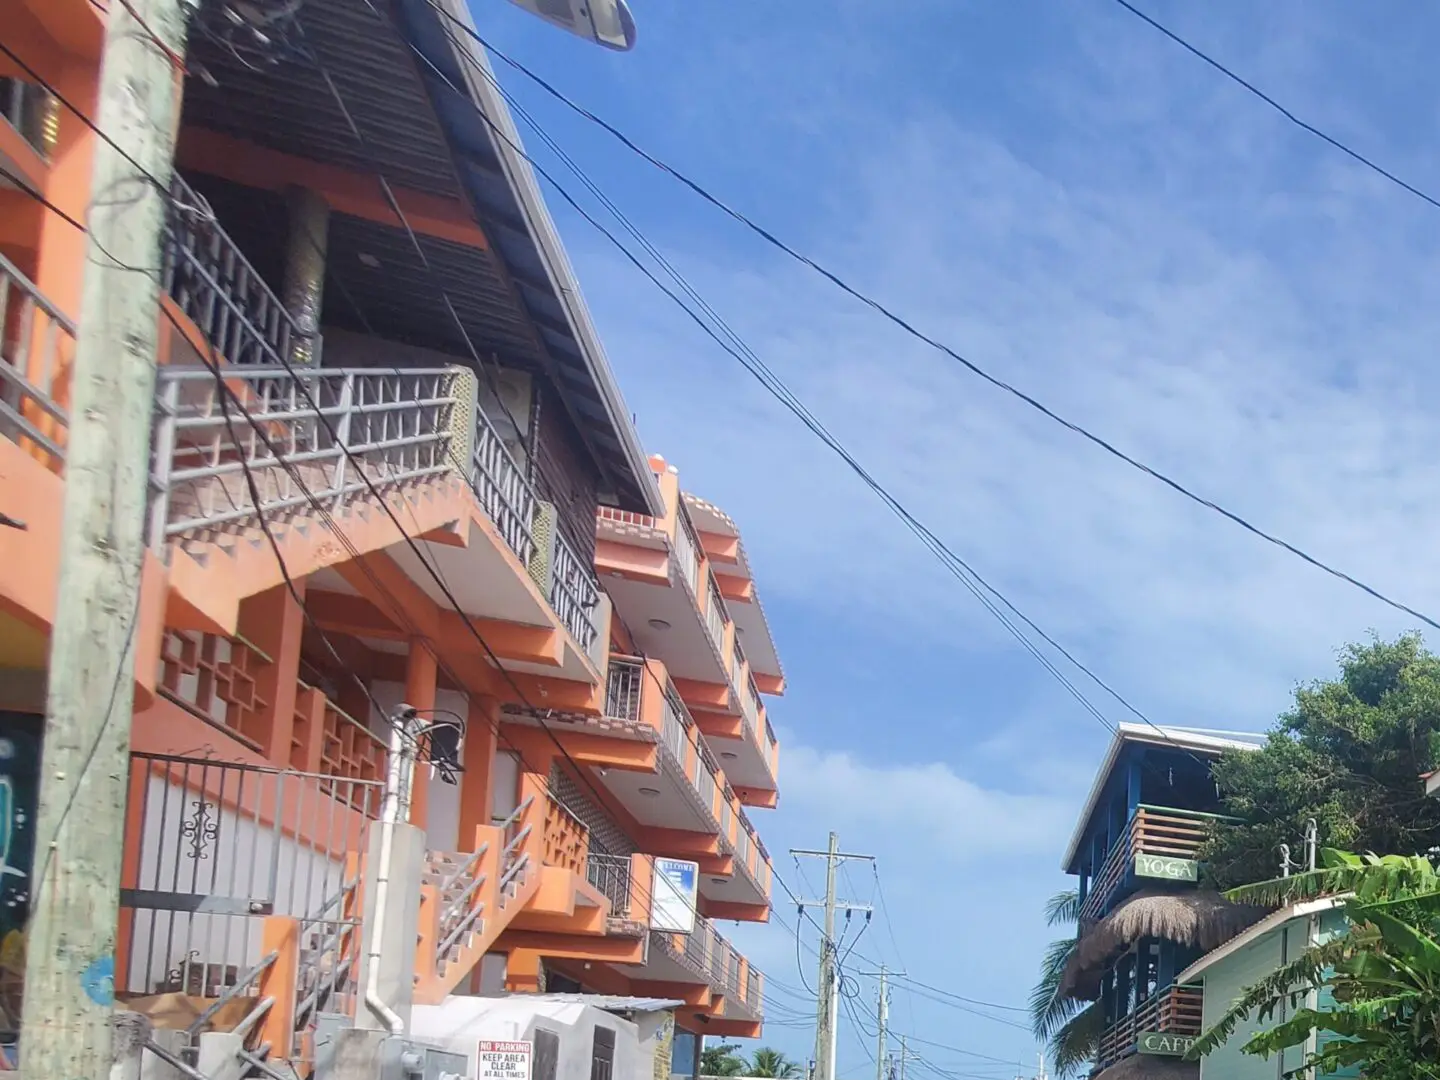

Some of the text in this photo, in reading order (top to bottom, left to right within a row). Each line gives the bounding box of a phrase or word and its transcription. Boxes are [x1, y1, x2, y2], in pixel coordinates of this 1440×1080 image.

[1142, 857, 1193, 878] YOGA
[480, 1042, 530, 1054] NO PARKING
[482, 1053, 525, 1063] KEEP AREA
[491, 1062, 516, 1071] CLEAR
[494, 1070, 504, 1078] ALL
[506, 1071, 526, 1079] TIMES
